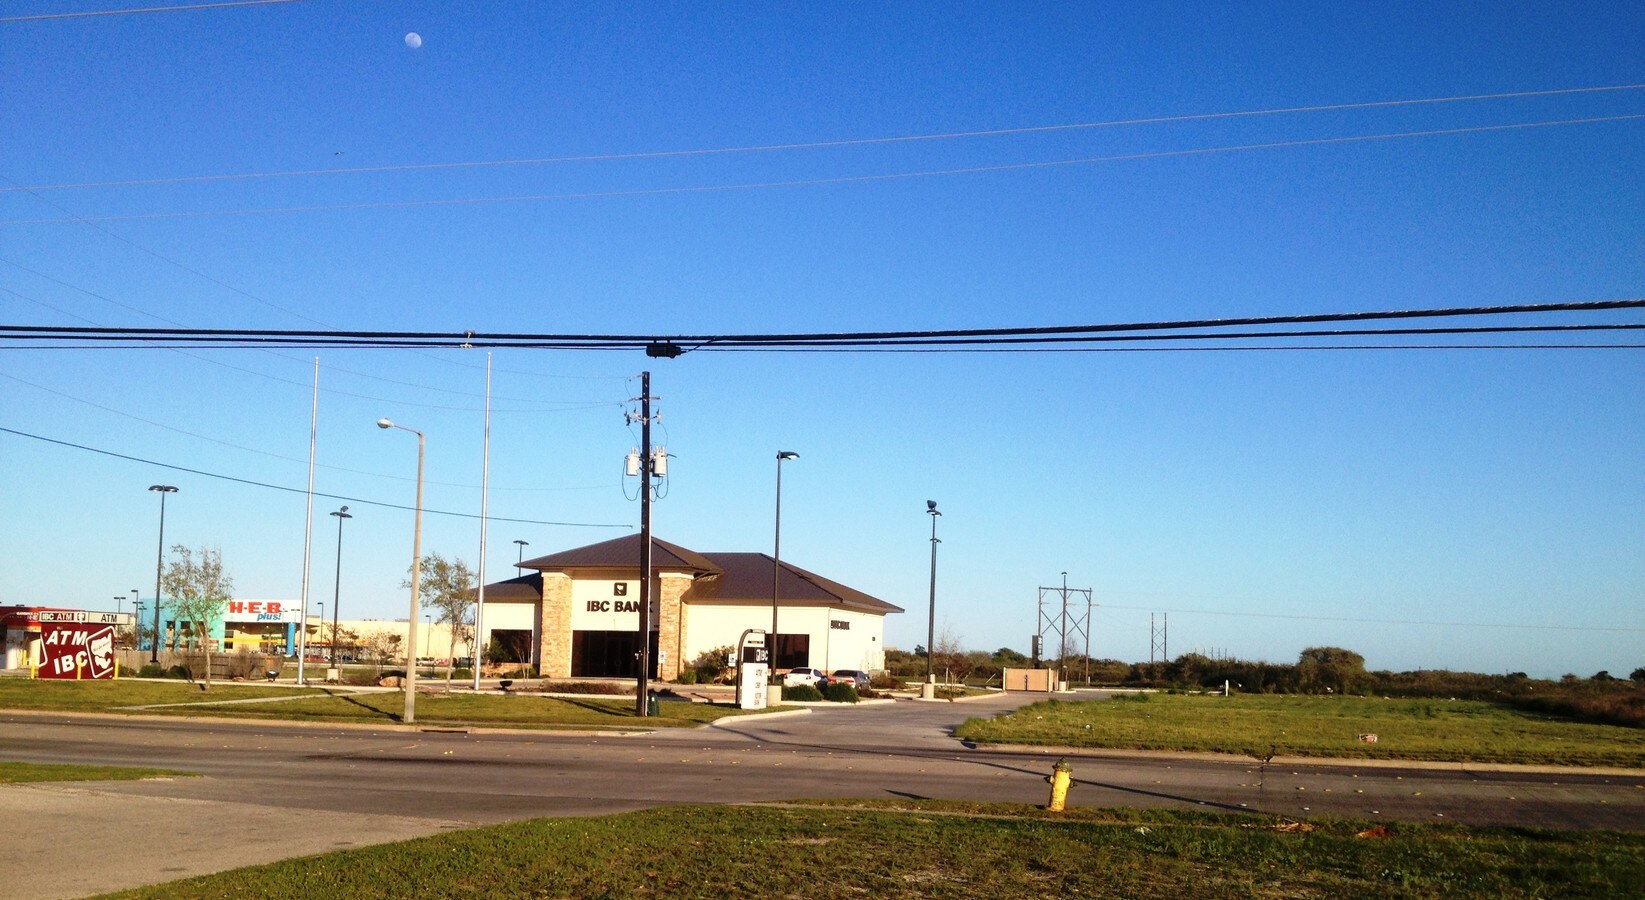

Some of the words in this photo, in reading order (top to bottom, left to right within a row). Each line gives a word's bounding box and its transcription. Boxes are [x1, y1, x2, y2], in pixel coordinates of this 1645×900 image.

[229, 602, 282, 614] H-E-B
[586, 600, 611, 613] IBC
[41, 612, 55, 621] IBC
[56, 613, 73, 621] ATM
[100, 614, 118, 623] ATM
[257, 613, 282, 622] plus!
[46, 630, 88, 646] ATM
[53, 650, 89, 675] IBC
